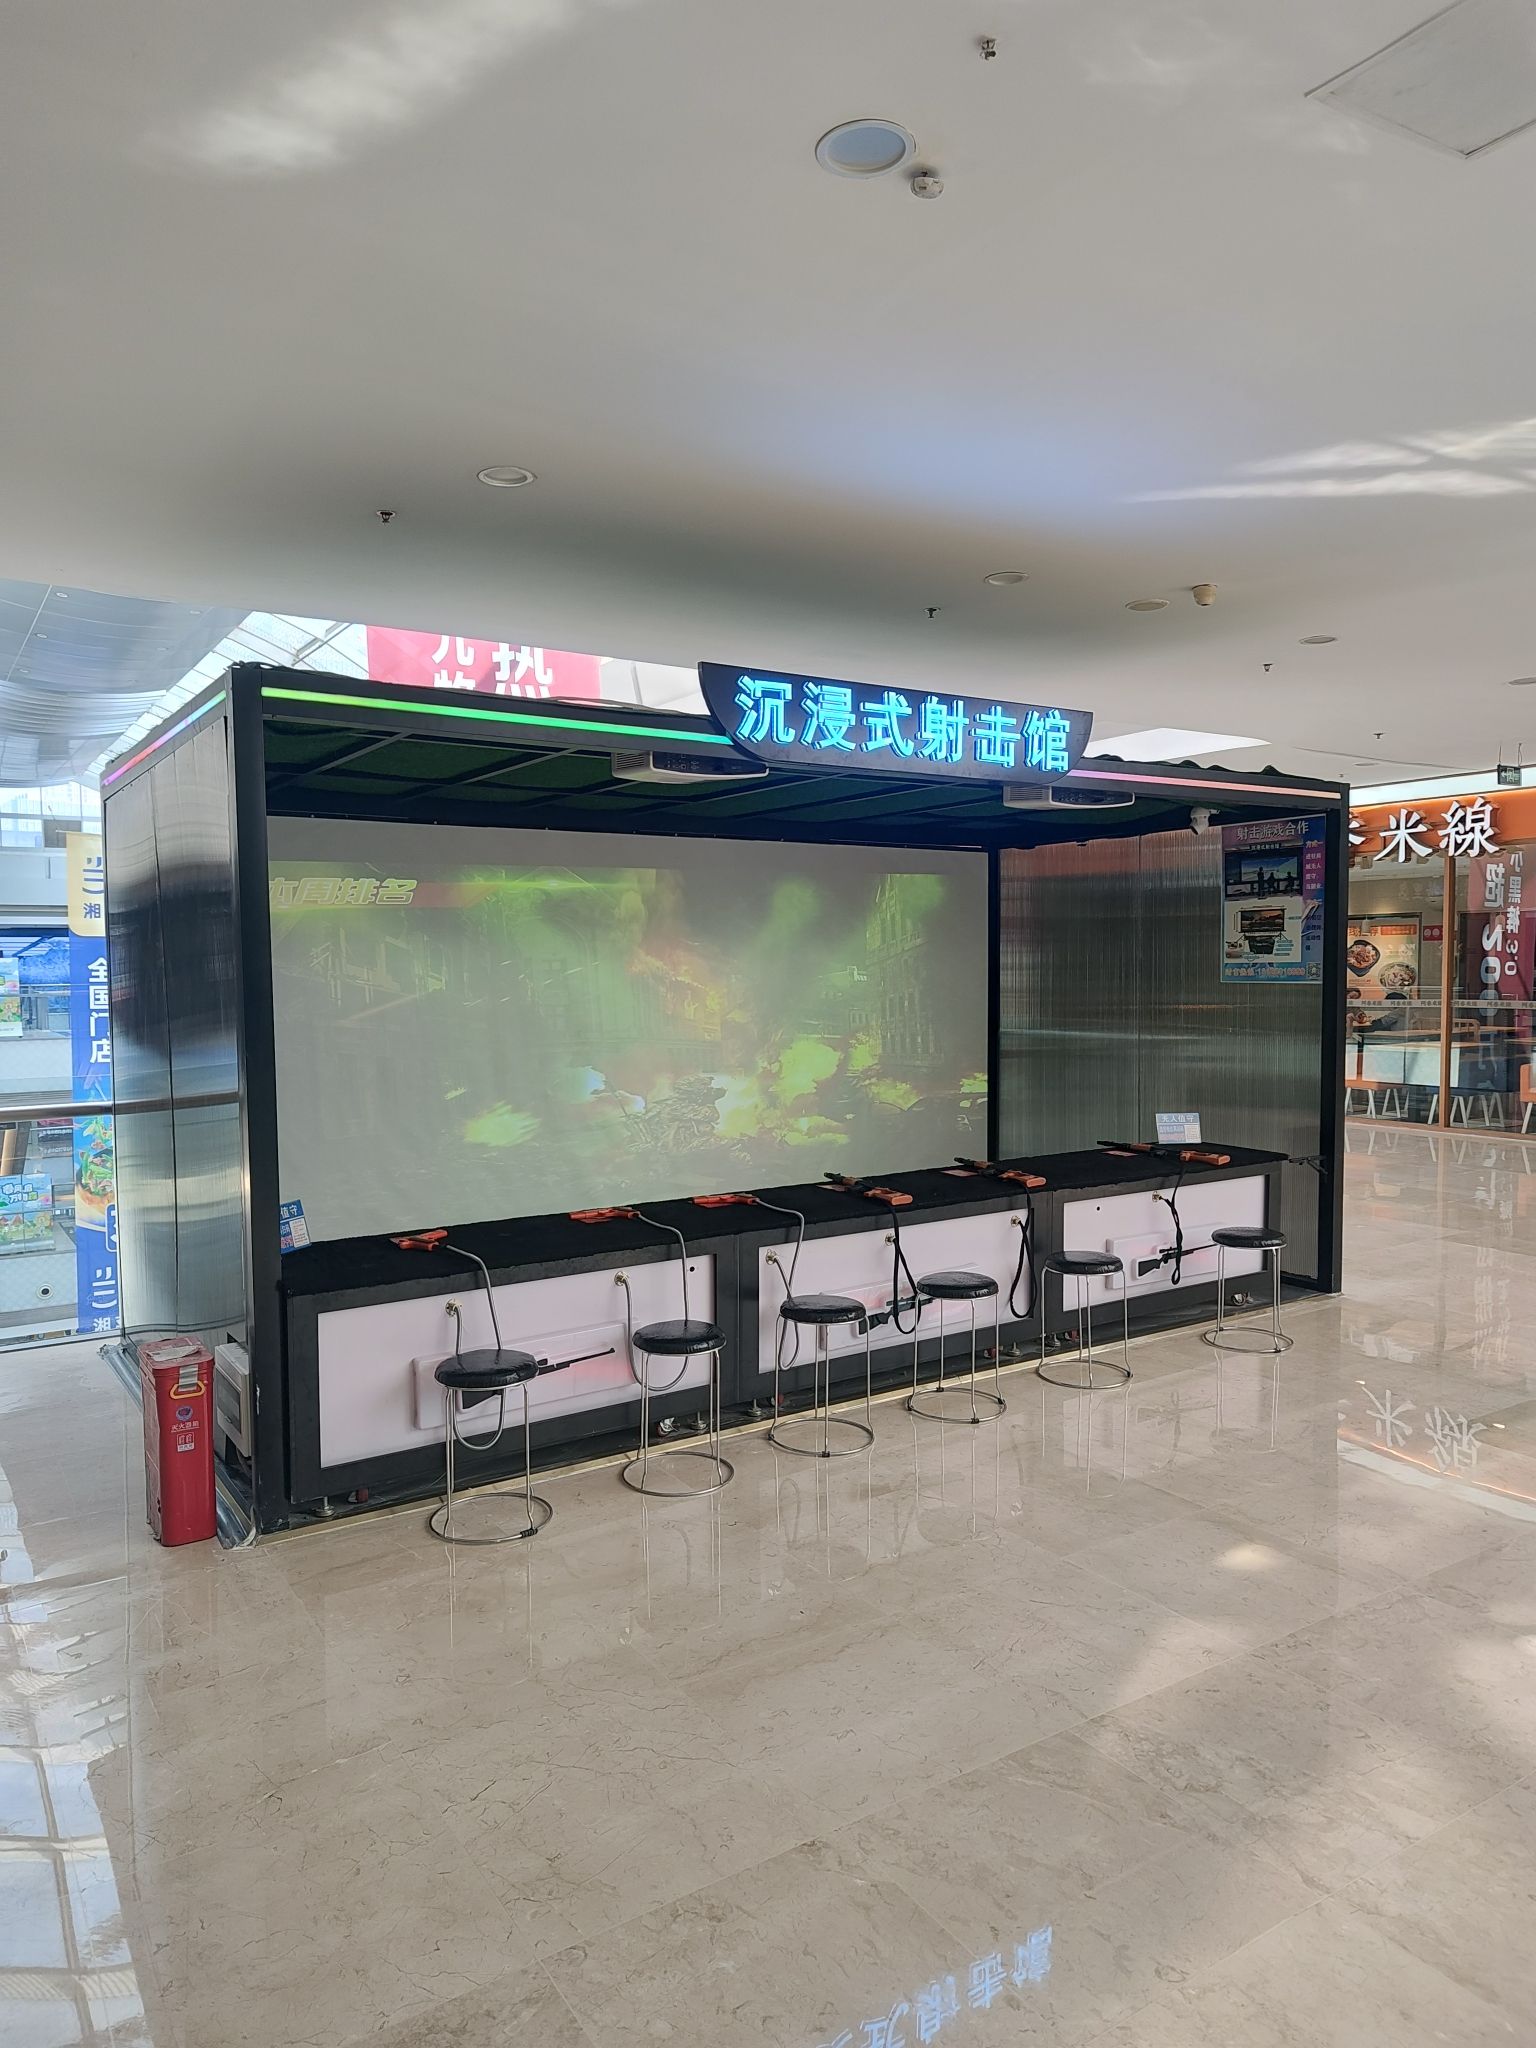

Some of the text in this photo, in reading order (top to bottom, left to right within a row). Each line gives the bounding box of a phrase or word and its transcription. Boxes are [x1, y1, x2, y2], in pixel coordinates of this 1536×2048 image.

[734, 674, 1071, 773] 沉浸式射击馆
[1236, 820, 1309, 840] 射击游戏合作
[1348, 796, 1500, 864] 米線
[1161, 1114, 1194, 1123] 无人值守
